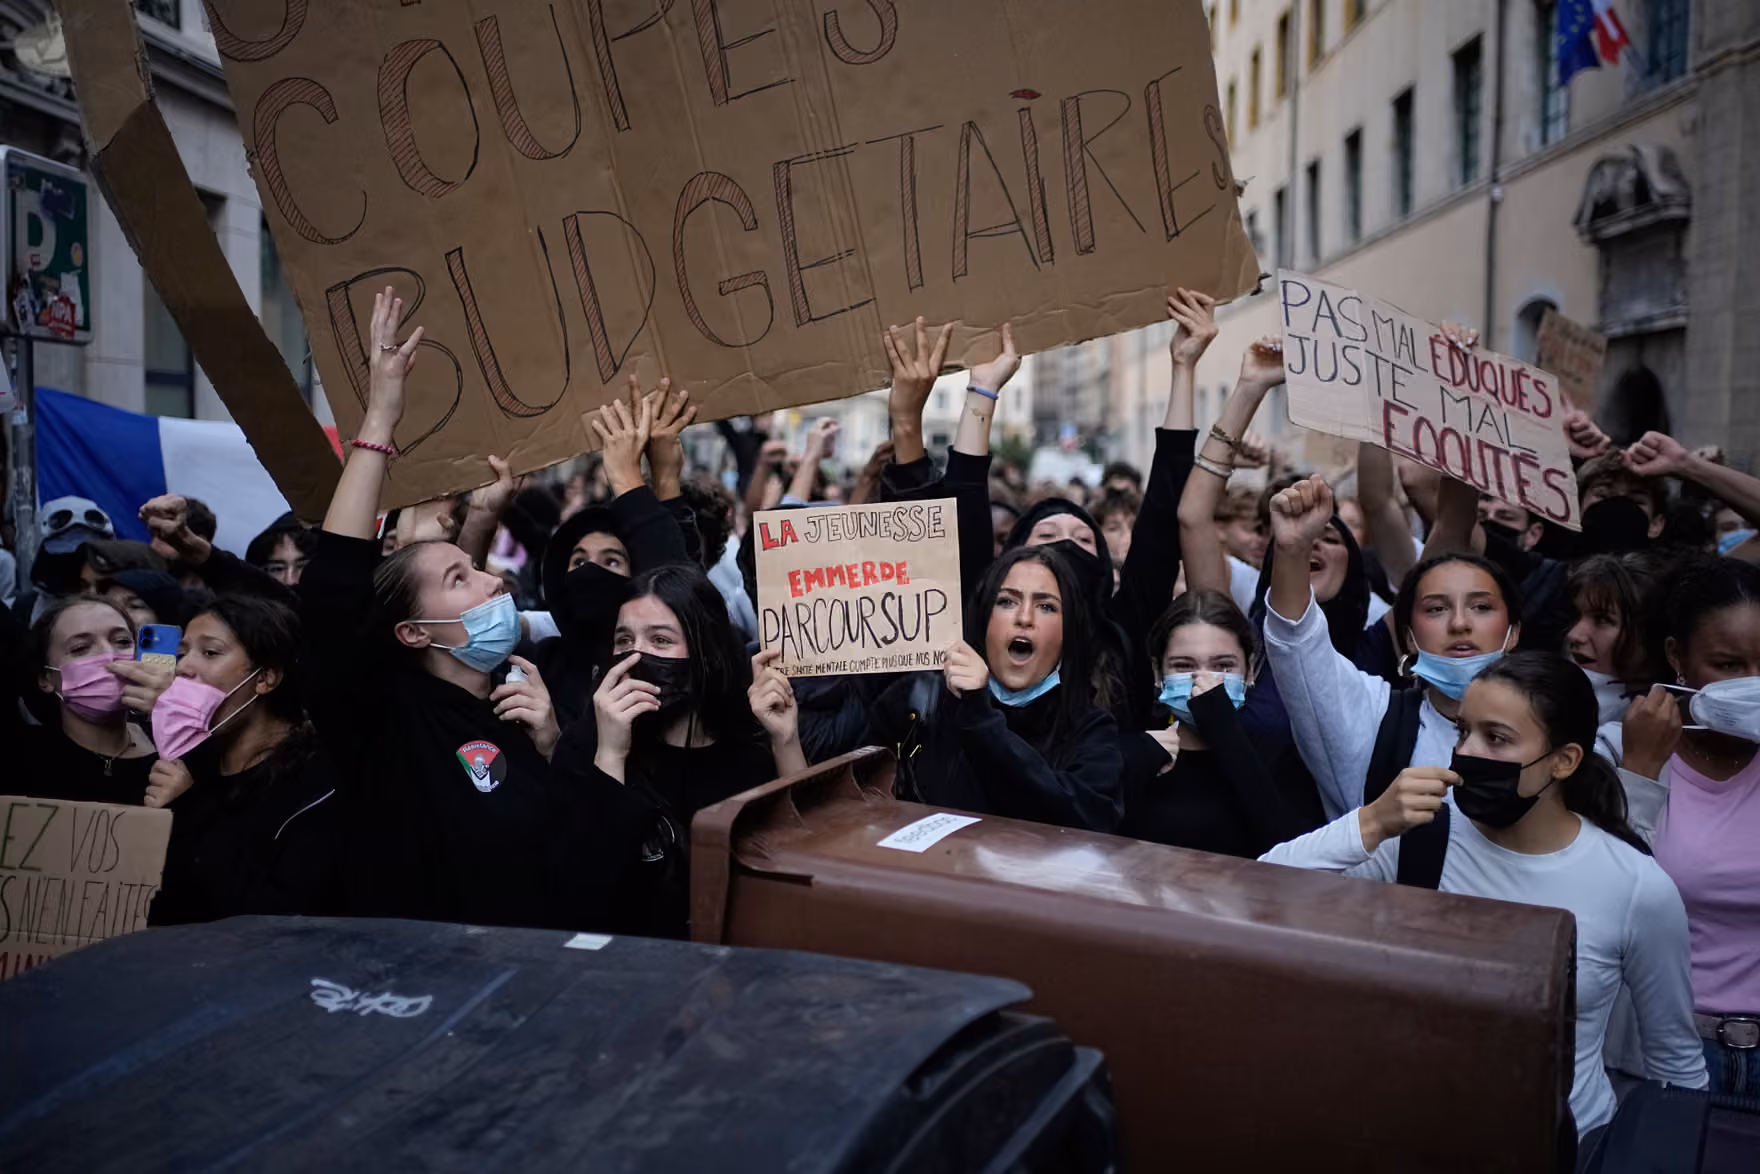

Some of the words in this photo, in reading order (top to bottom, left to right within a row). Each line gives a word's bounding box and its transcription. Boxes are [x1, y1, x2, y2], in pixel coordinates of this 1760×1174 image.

[1280, 279, 1368, 342] PAS
[1371, 309, 1429, 373] MAL
[1288, 333, 1418, 411] JUSTE
[1439, 385, 1537, 454] MAL
[759, 519, 800, 551] LA
[803, 505, 946, 544] JEUNESSE
[787, 560, 912, 598] EMMERDE
[763, 588, 948, 664] PARCOURSUP
[815, 661, 848, 675] MENTALE
[70, 807, 126, 873] VOS
